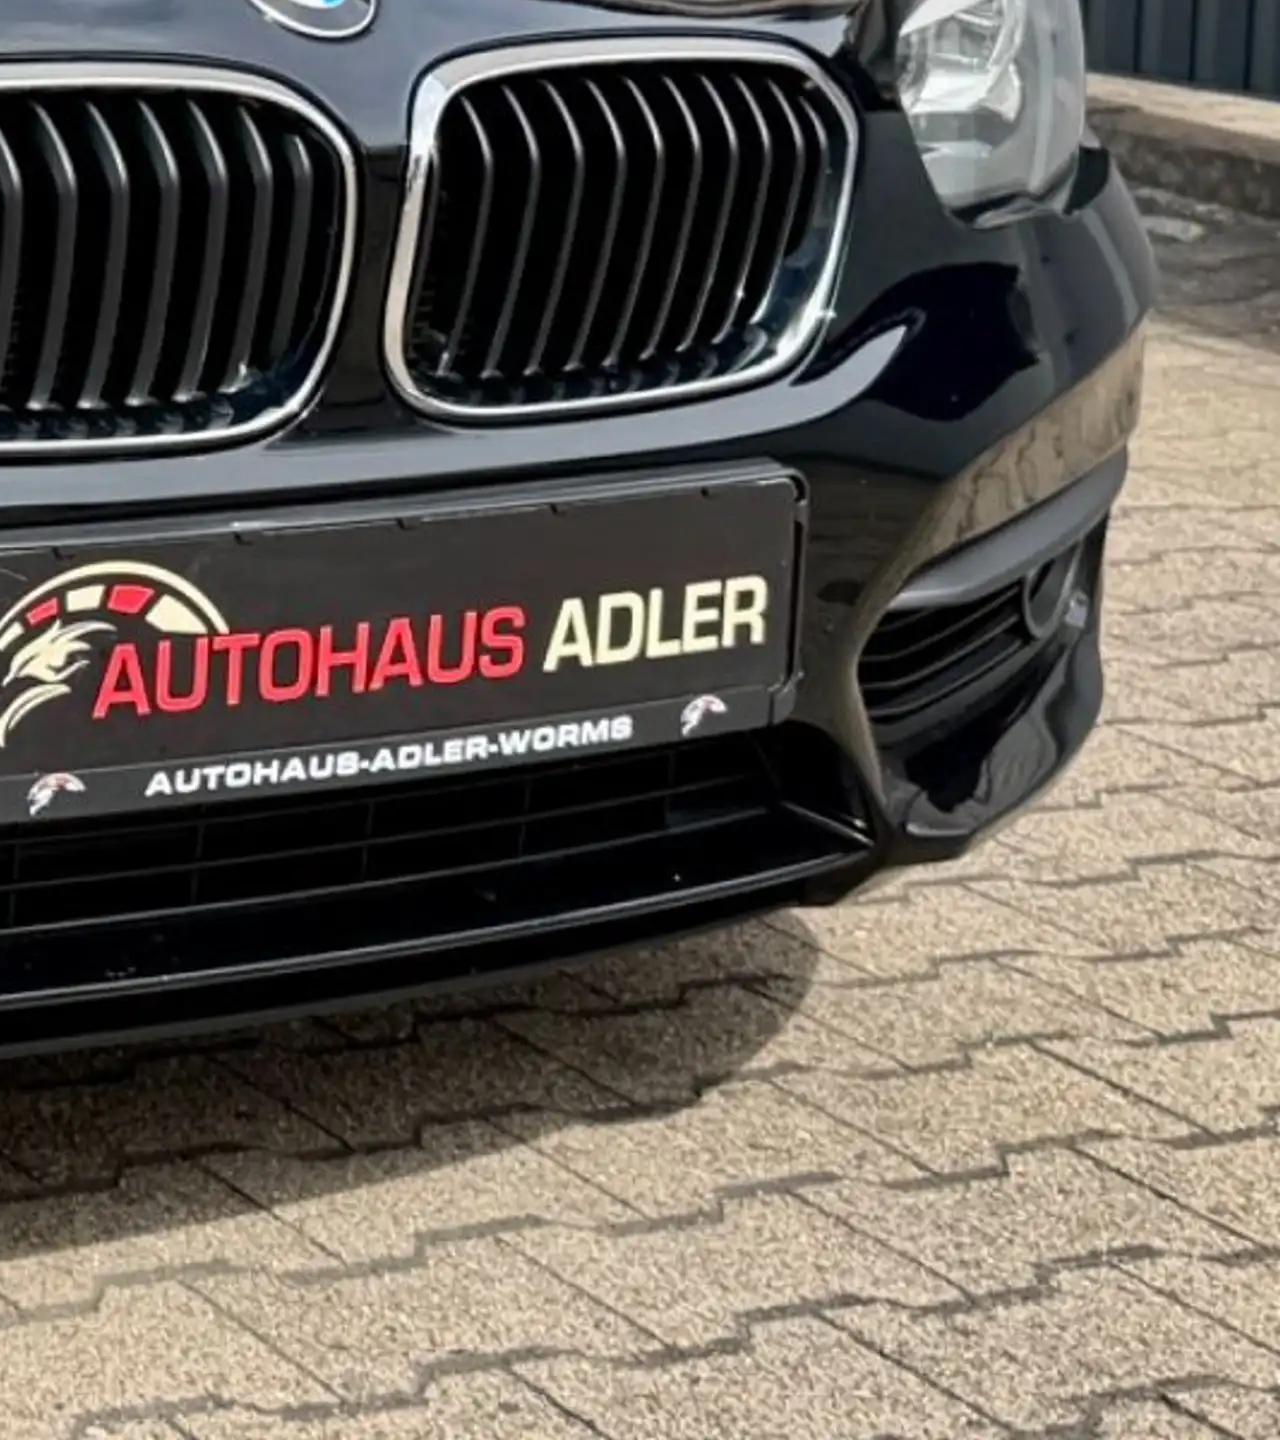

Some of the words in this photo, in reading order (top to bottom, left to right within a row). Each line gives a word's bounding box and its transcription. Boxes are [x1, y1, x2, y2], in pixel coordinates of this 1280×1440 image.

[92, 605, 526, 720] AUTOHAUS
[543, 574, 768, 673] ADLER
[145, 714, 633, 798] AUTOHAUS-ADLER-WORMS
